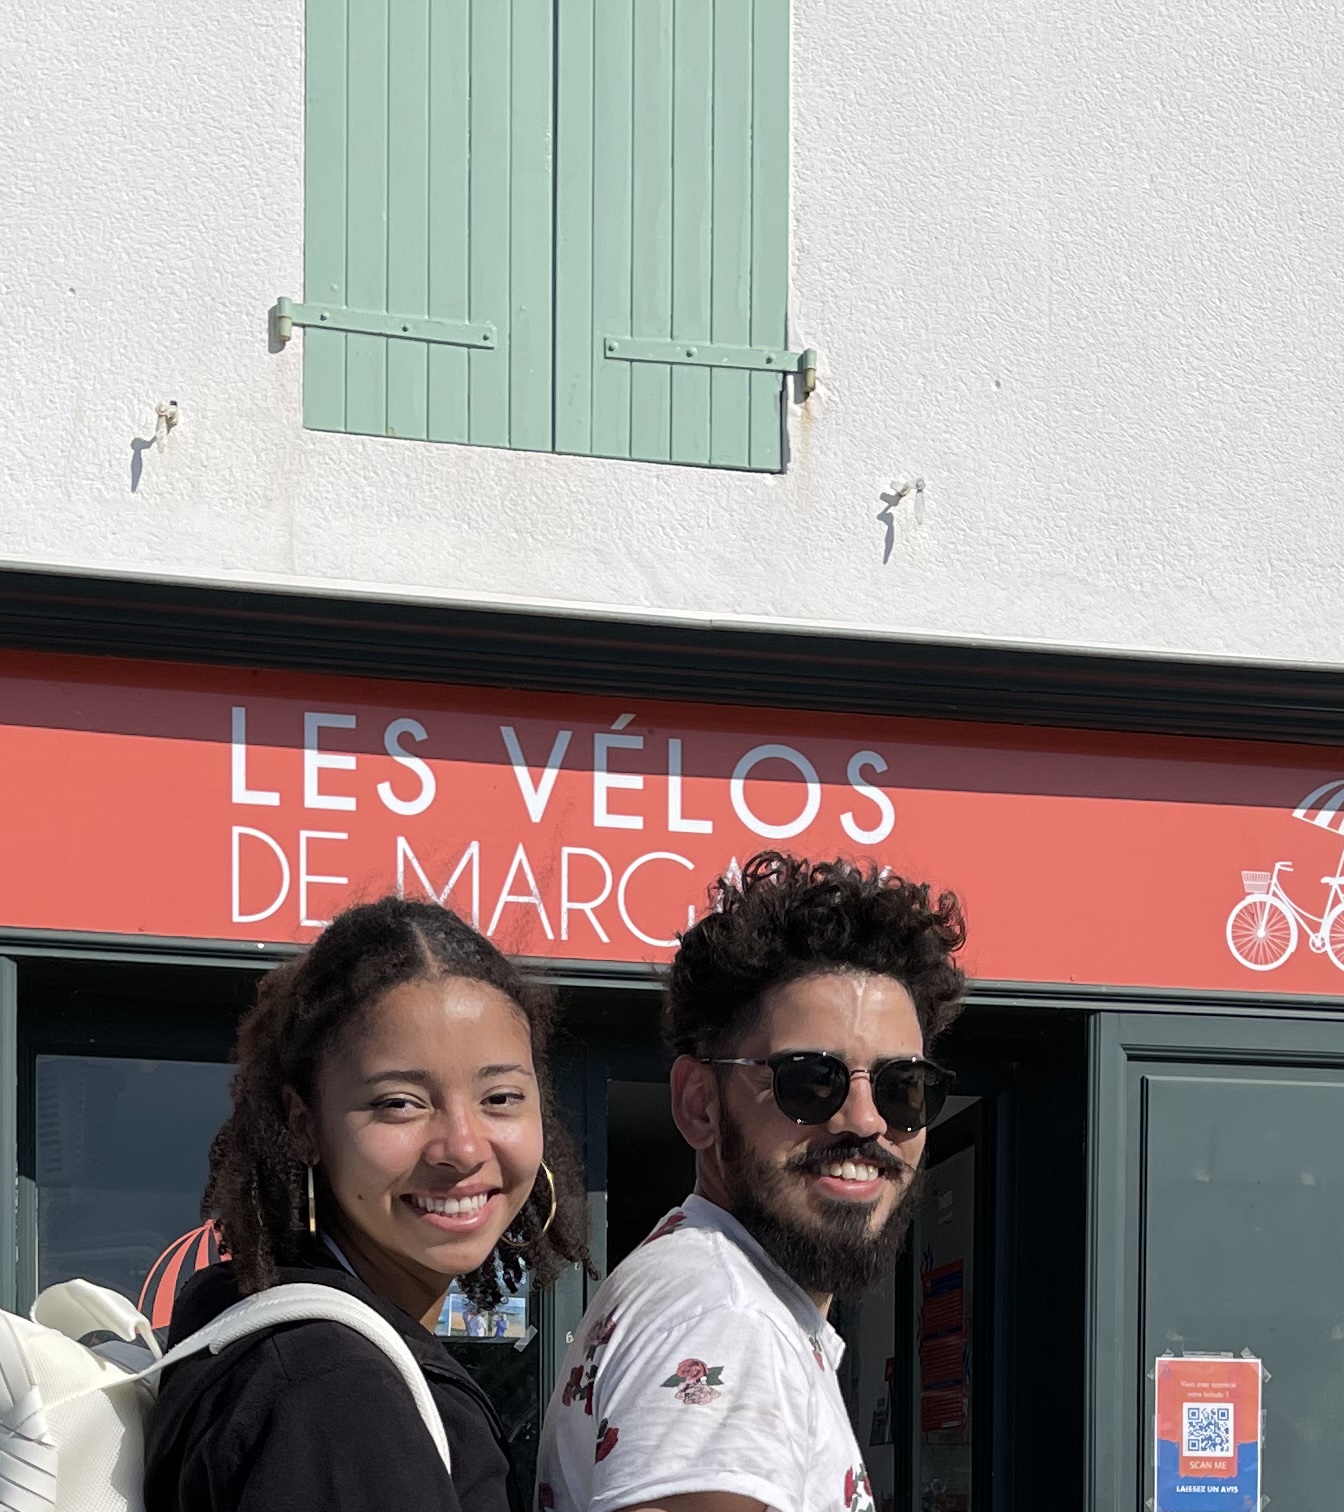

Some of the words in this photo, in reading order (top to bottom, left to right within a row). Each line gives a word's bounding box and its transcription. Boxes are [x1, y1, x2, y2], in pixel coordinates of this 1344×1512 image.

[230, 706, 436, 816] LES
[500, 713, 895, 844] VÉLOS
[230, 826, 349, 928] DE
[1176, 1485, 1206, 1493] LAISSEZ
[1207, 1485, 1220, 1493] UN
[1220, 1485, 1239, 1494] AVIS
[1189, 1461, 1212, 1470] SCAN
[1214, 1461, 1227, 1470] ME
